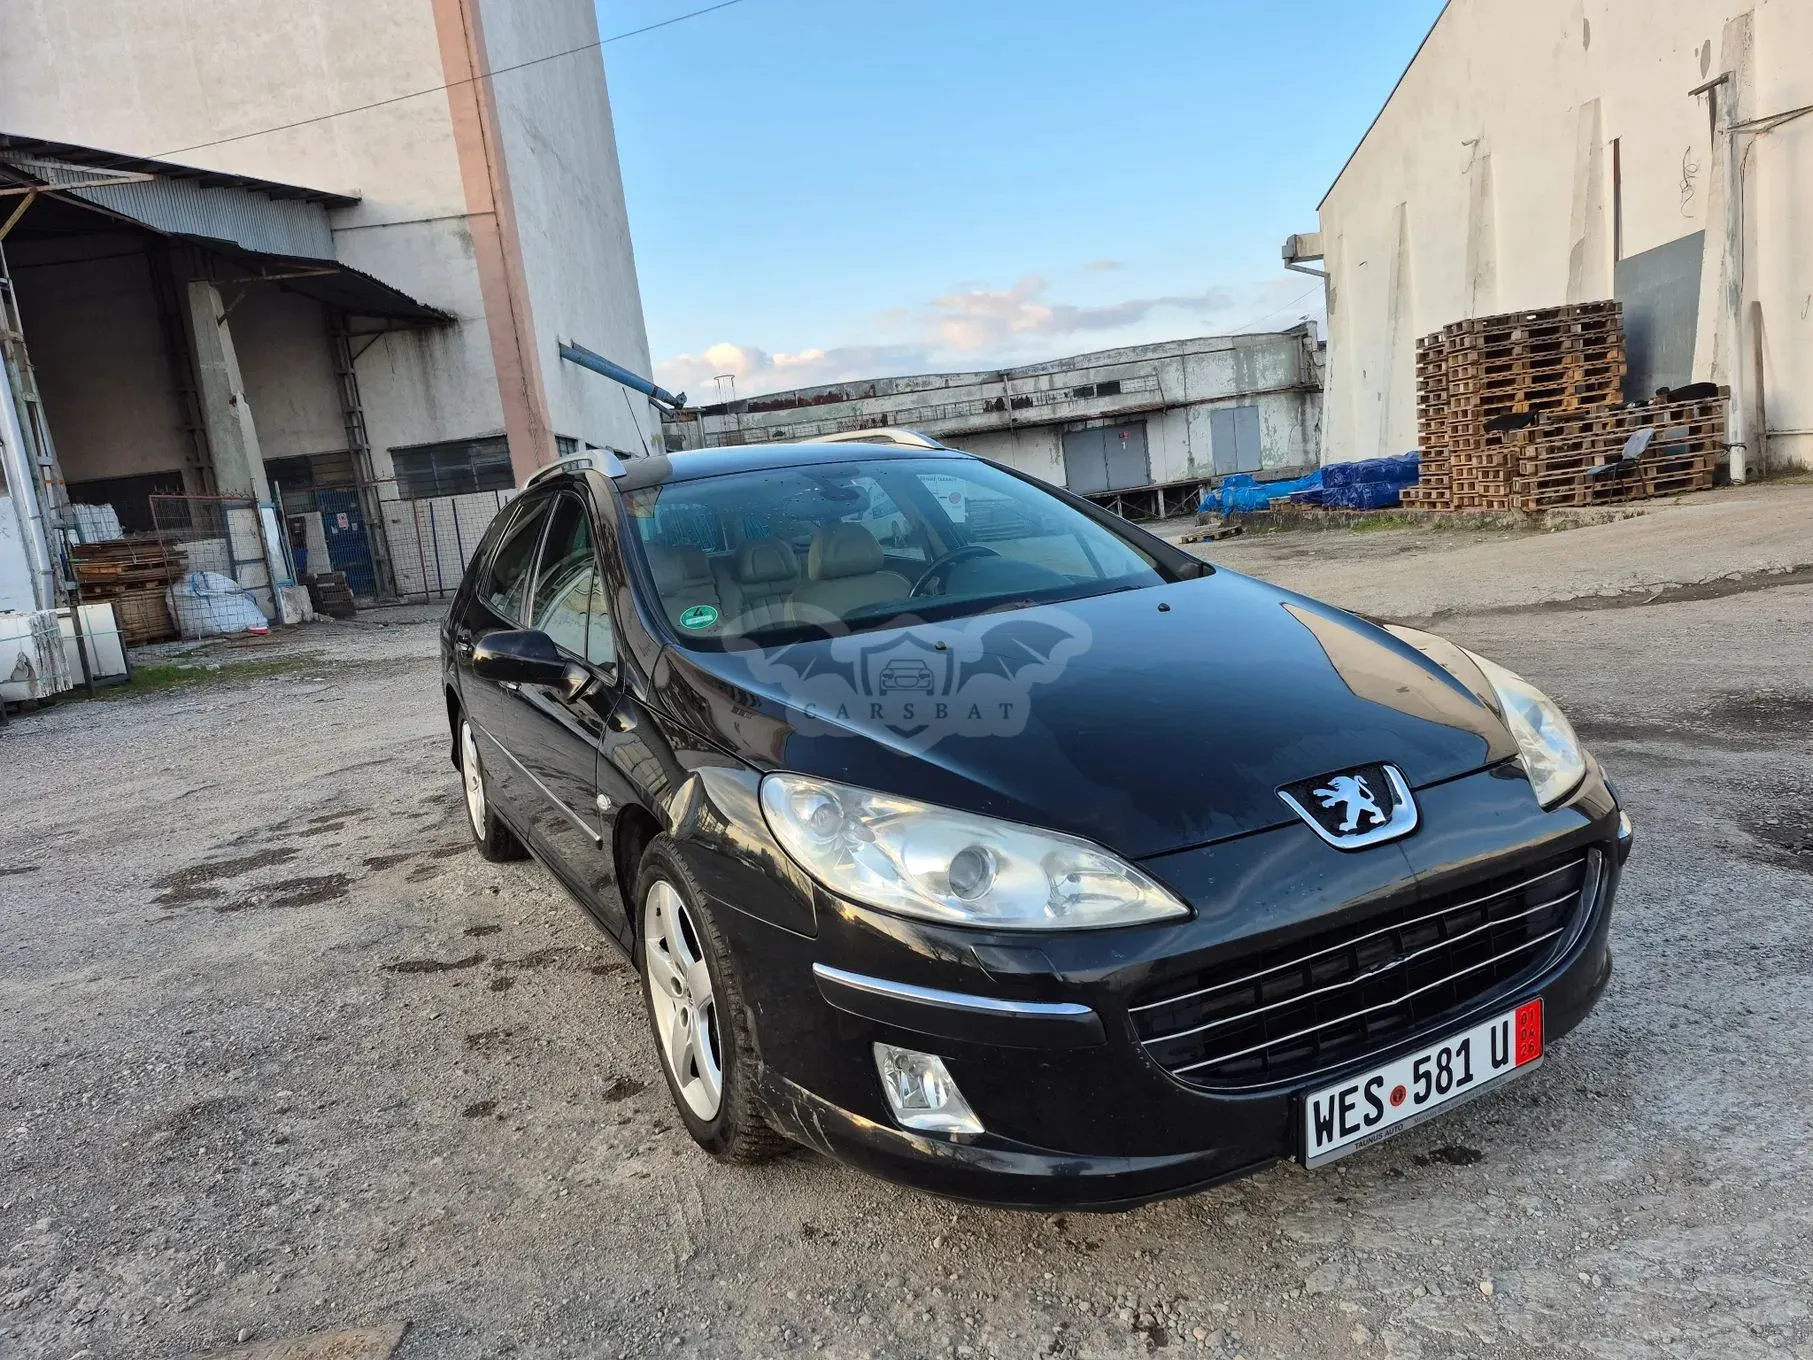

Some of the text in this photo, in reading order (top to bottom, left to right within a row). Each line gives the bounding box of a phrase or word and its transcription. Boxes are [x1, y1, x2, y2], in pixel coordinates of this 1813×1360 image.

[693, 607, 704, 617] 4
[1521, 1008, 1534, 1026] 01
[1313, 1075, 1384, 1147] WES
[1413, 1037, 1473, 1104] 581
[1491, 1020, 1508, 1069] U
[1354, 1123, 1404, 1149] TAUNUS AUTO
